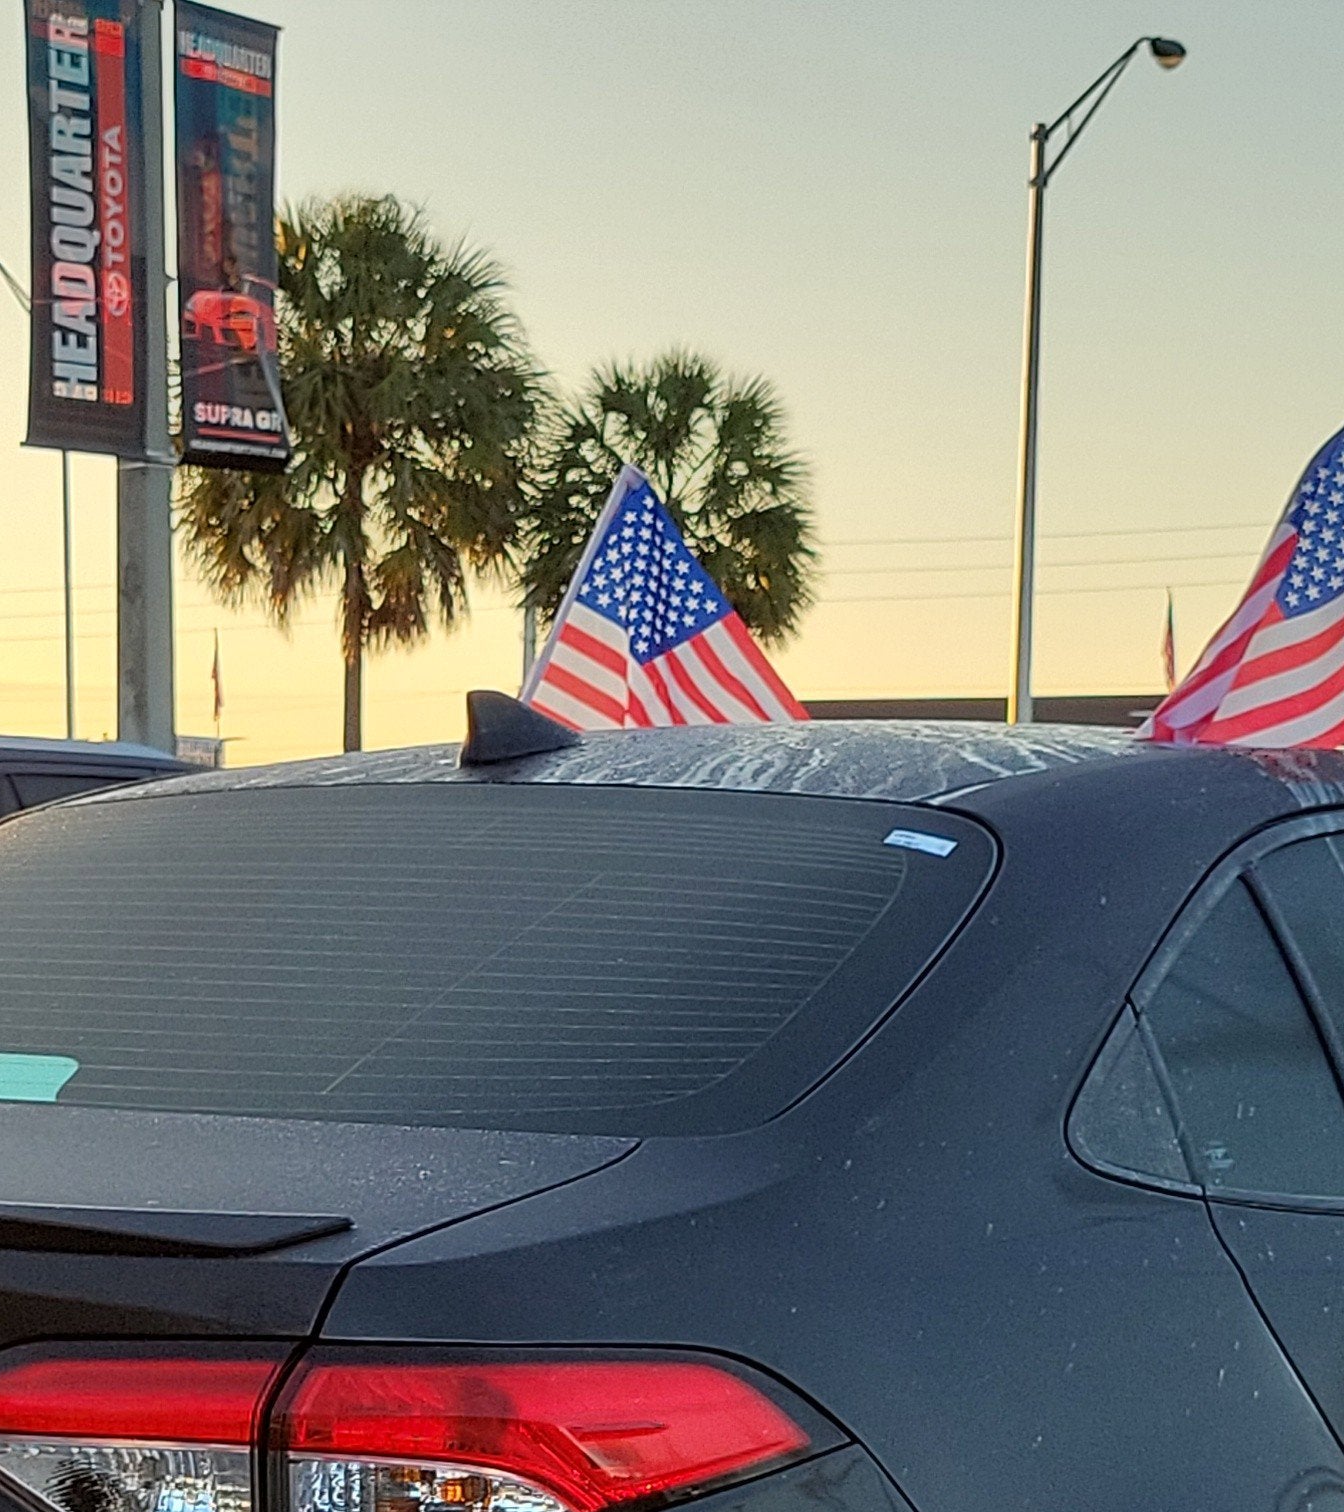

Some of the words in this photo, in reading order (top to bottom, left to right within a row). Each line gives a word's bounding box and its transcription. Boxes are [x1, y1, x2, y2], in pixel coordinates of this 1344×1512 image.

[48, 13, 98, 401] HEADQUARTER
[103, 126, 126, 266] TOYOTA
[194, 402, 254, 429] SUPRA
